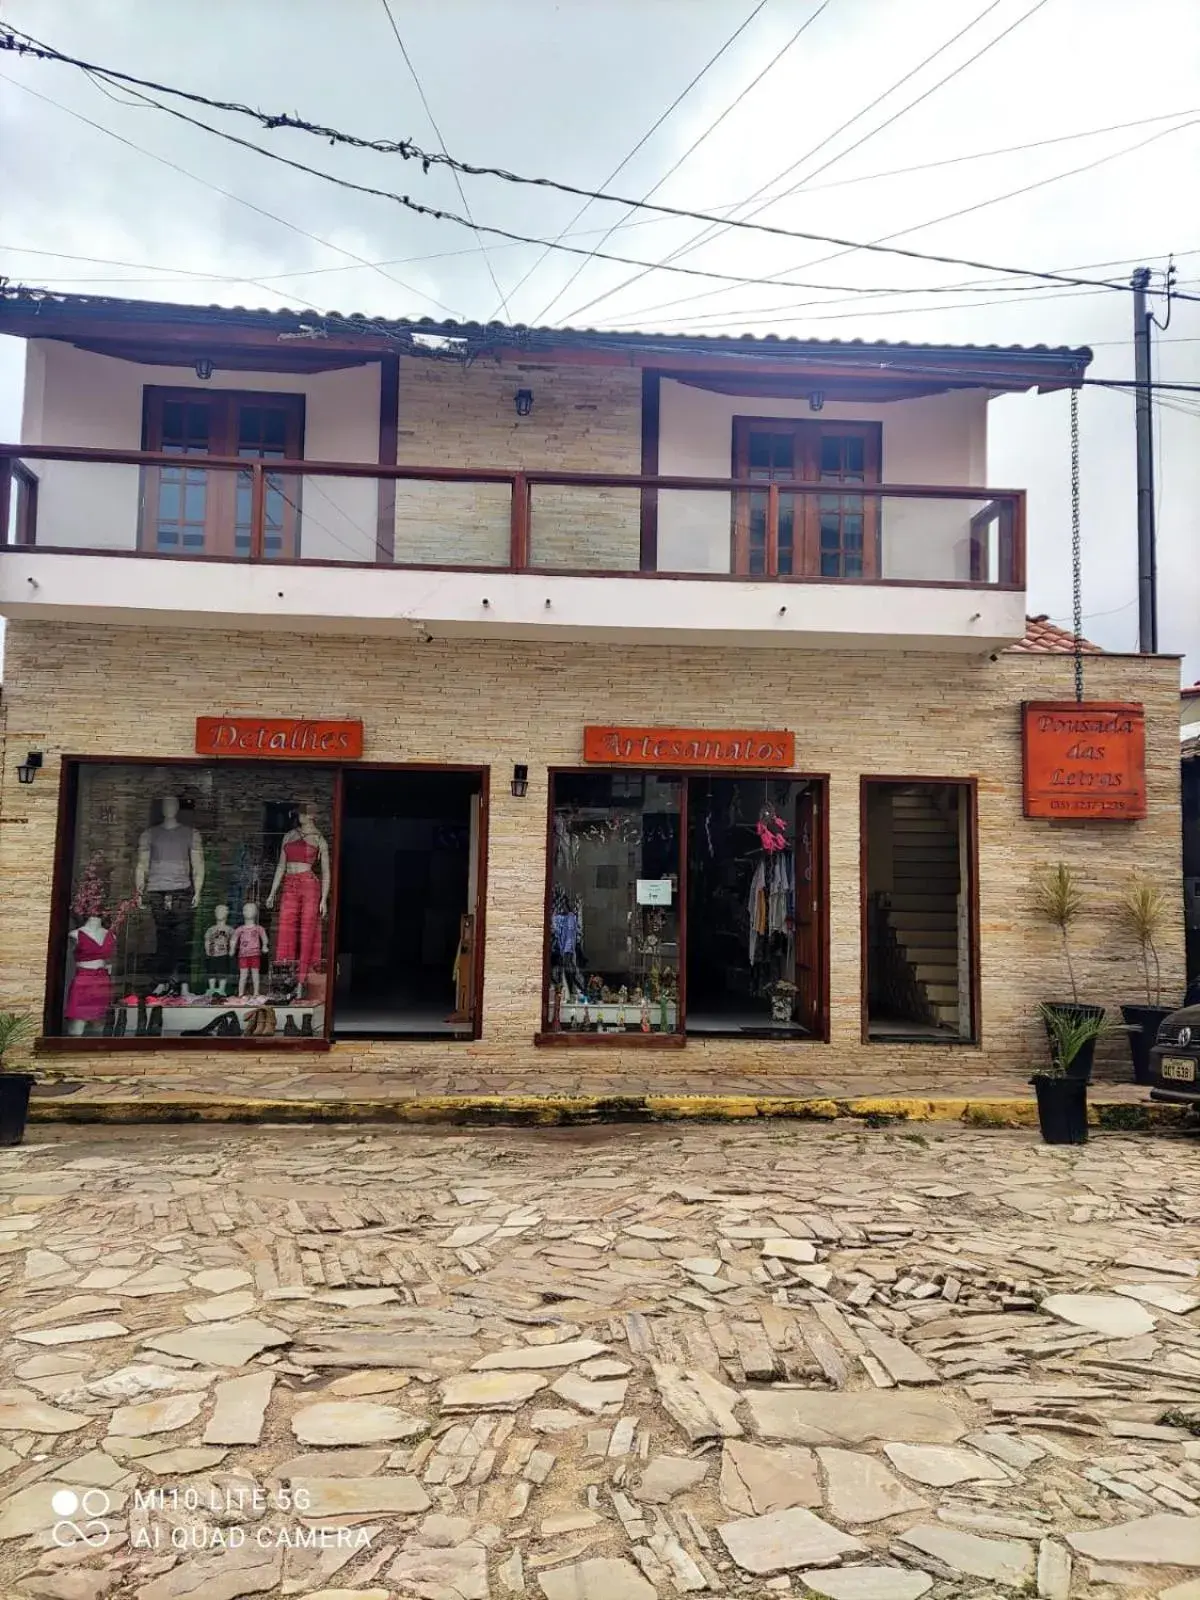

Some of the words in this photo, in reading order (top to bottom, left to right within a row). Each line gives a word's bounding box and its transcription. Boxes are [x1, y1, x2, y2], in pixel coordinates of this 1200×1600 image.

[1038, 714, 1133, 734] Pousada
[210, 722, 348, 751] Detalhes
[603, 731, 787, 761] Artesanatos
[1067, 740, 1106, 760] das
[1050, 768, 1123, 787] Letras
